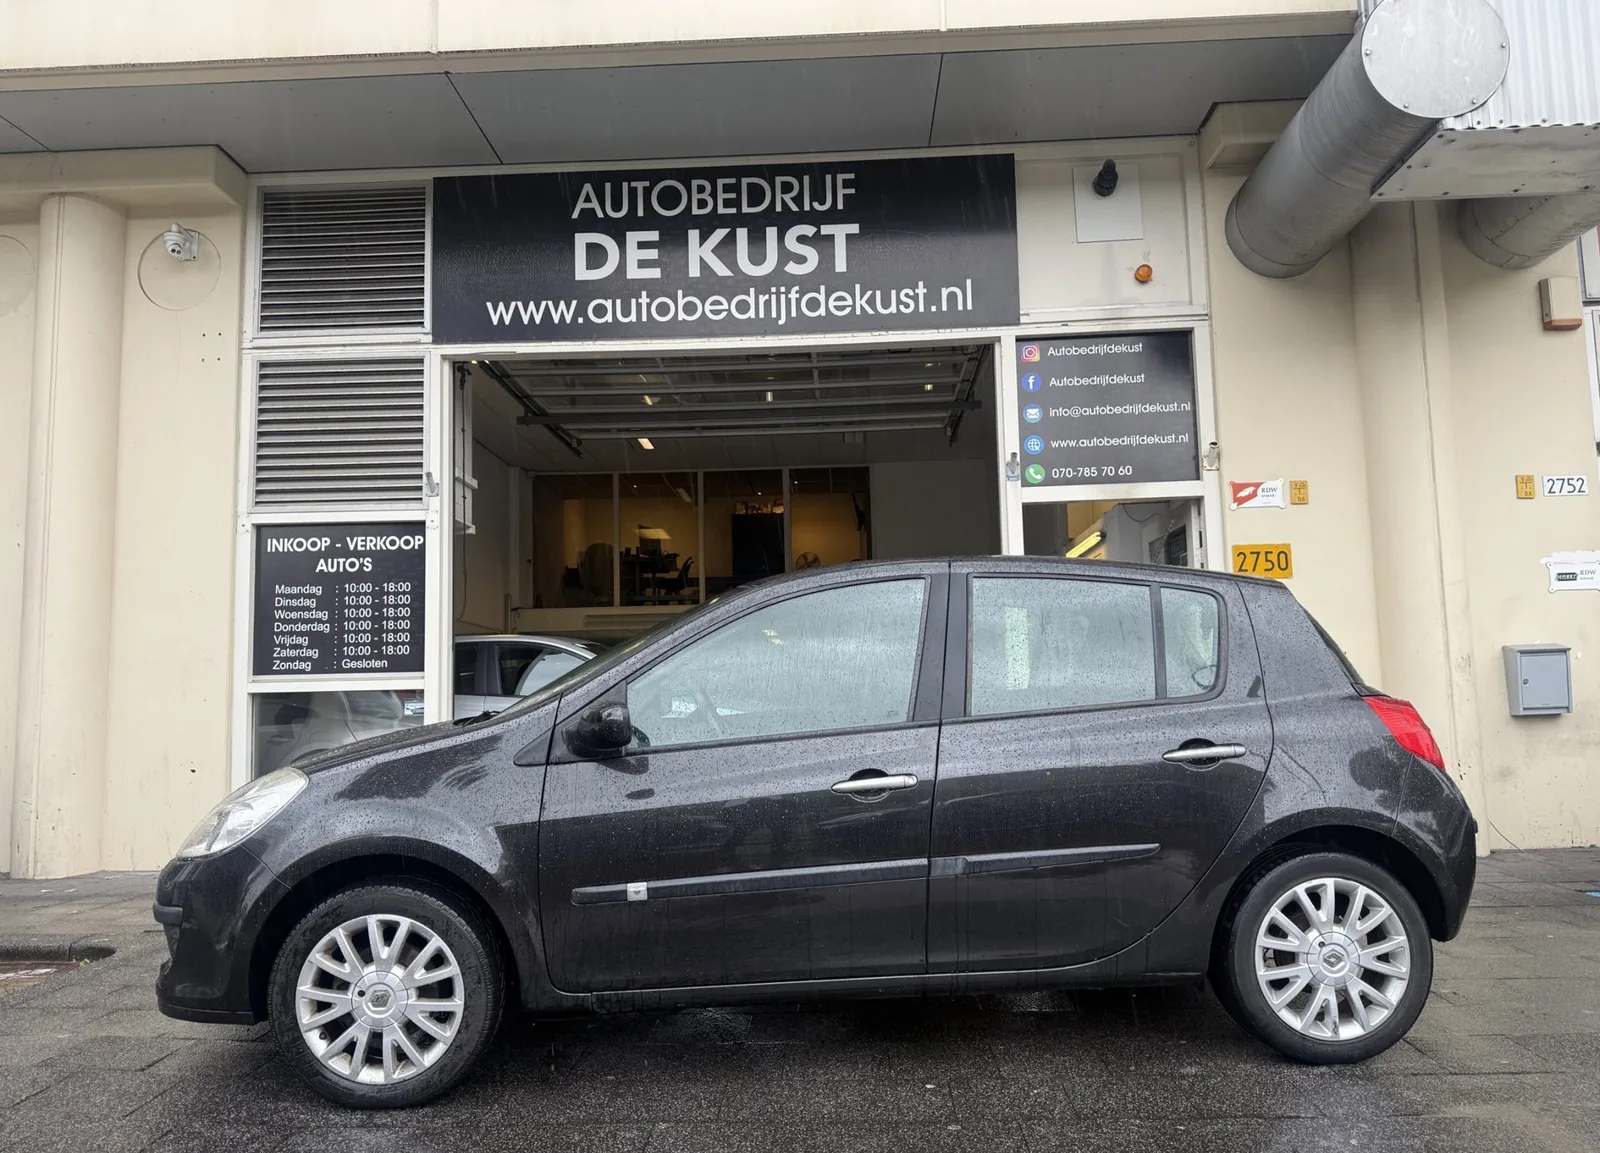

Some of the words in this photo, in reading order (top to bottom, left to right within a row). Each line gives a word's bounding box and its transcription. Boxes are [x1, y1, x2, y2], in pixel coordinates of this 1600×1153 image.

[571, 172, 856, 219] AUTOBEDRIJF
[574, 230, 662, 281] DE
[687, 223, 860, 278] KUST
[485, 278, 973, 327] www.autobedrijfdekust.nl
[1047, 342, 1143, 356] Autobedrijfdekust
[1049, 373, 1145, 387] Autobedrijfdekust
[1049, 401, 1191, 417] info@autobedrijfdekust.nl
[1050, 433, 1189, 448] www.autobedrijfdekust.nl
[1051, 467, 1098, 479] 070-785
[1101, 466, 1115, 477] 70
[1117, 465, 1133, 476] 60
[1546, 477, 1586, 494] 2752
[267, 537, 331, 553] INKOOP
[345, 535, 424, 551] VERKOOP
[315, 557, 373, 573] AUTO'S
[1236, 550, 1289, 573] 2750
[276, 584, 322, 595] Maandag
[344, 582, 373, 593] 10:00
[382, 581, 411, 592] 18:00
[275, 597, 316, 608] Dinsdag
[344, 595, 372, 606] 10:00
[382, 594, 411, 605] 18:00
[274, 609, 329, 620] Woensdag
[343, 607, 372, 618] 10:00
[382, 607, 411, 617] 18:00
[274, 622, 330, 633] Donderdag
[343, 620, 372, 631] 10:00
[381, 619, 411, 630] 18:00
[274, 635, 309, 646] Vrijdag
[343, 633, 371, 643] 10:00
[381, 632, 411, 643] 18:00
[273, 647, 319, 659] Zaterdag
[342, 645, 371, 656] 10:00
[381, 645, 410, 655] 18:00
[272, 660, 312, 671] Zondag
[341, 658, 388, 669] Gesloten
